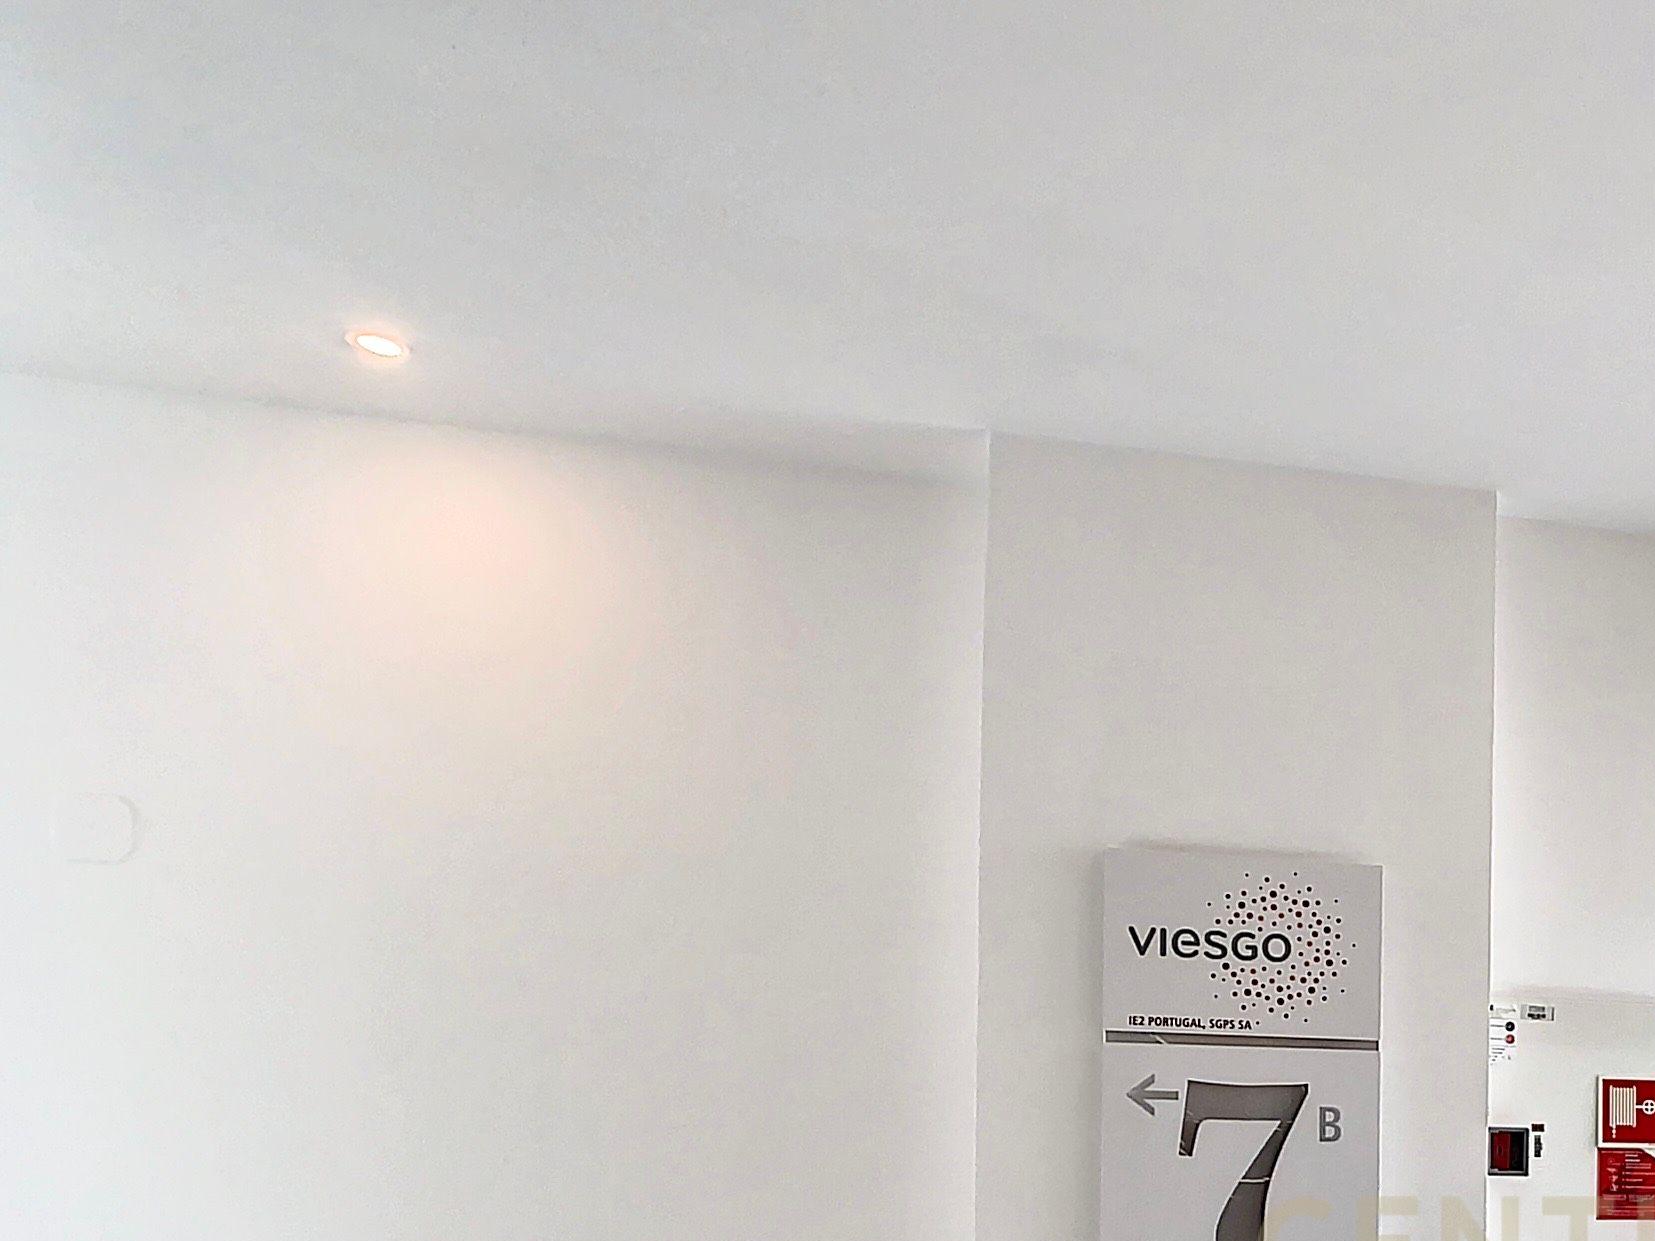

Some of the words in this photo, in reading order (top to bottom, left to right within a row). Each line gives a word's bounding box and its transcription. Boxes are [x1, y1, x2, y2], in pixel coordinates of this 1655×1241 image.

[1128, 1015, 1145, 1026] IE2
[1148, 1016, 1206, 1030] PORTUGAL,
[1209, 1019, 1235, 1030] SGPS
[1238, 1020, 1252, 1030] SA
[1319, 1106, 1342, 1142] B
